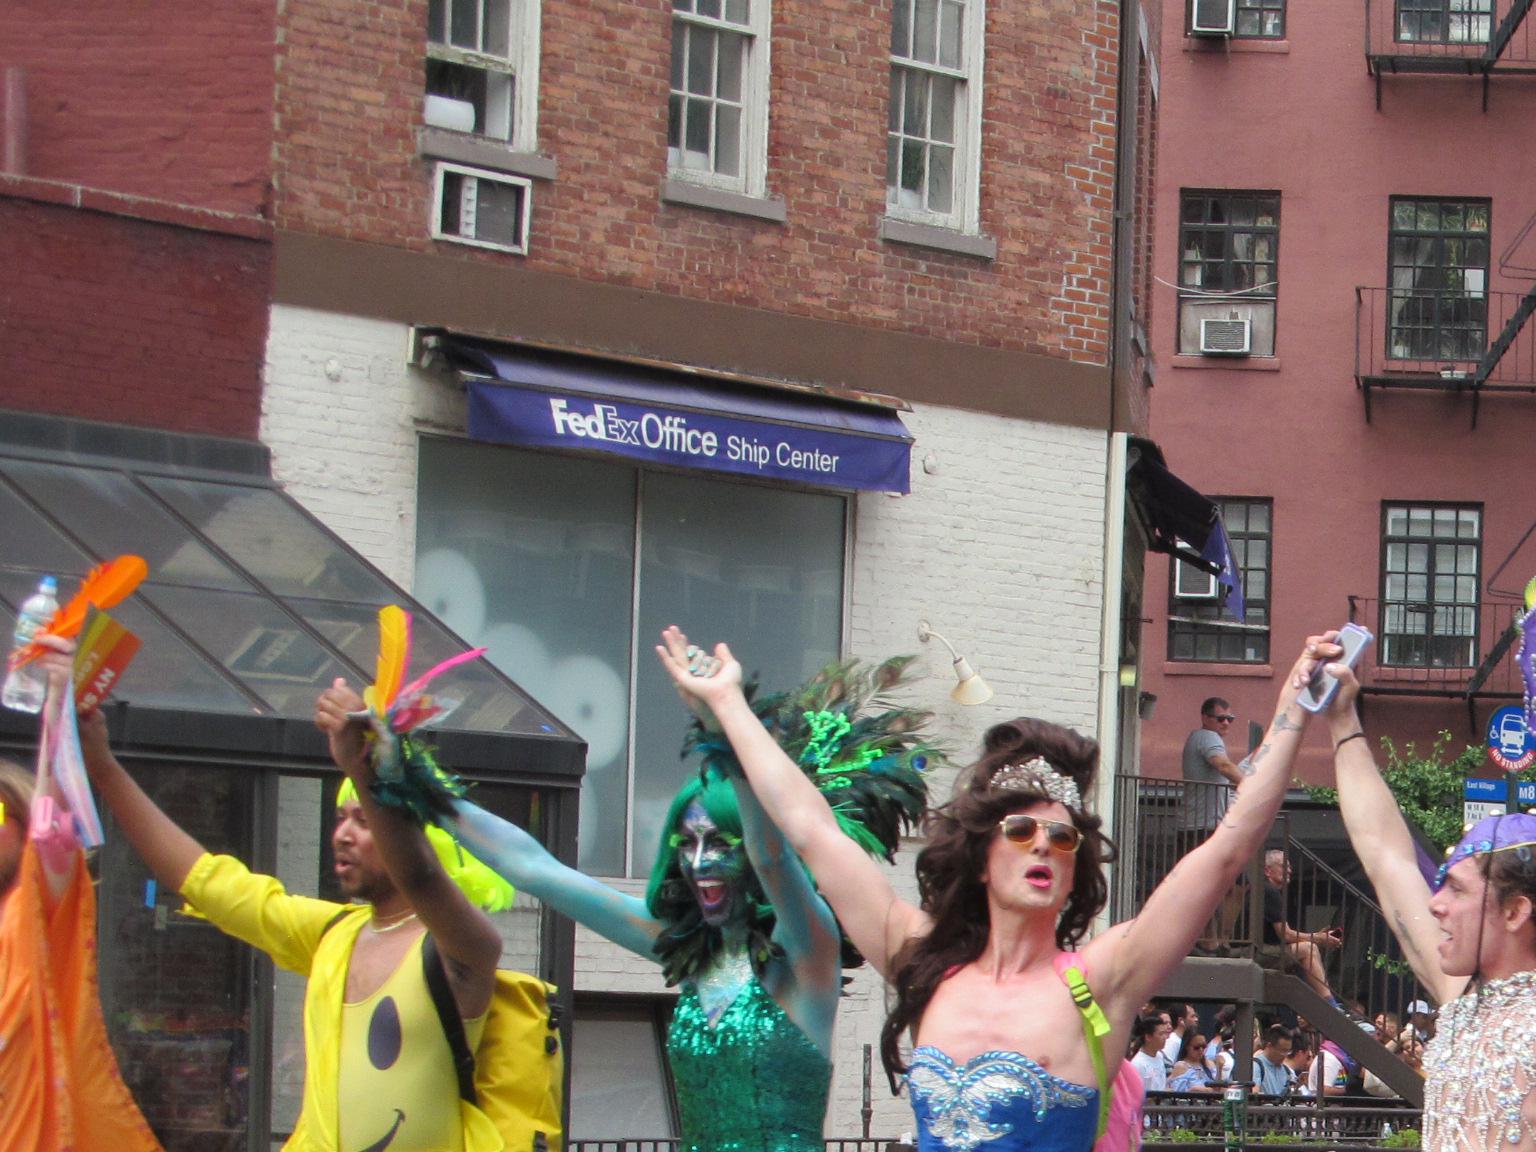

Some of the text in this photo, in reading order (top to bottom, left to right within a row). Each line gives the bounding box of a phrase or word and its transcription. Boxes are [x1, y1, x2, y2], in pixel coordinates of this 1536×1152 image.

[549, 398, 840, 473] FedEx Office Ship Center
[1491, 748, 1534, 770] NO STANDING
[1519, 785, 1535, 800] M8
